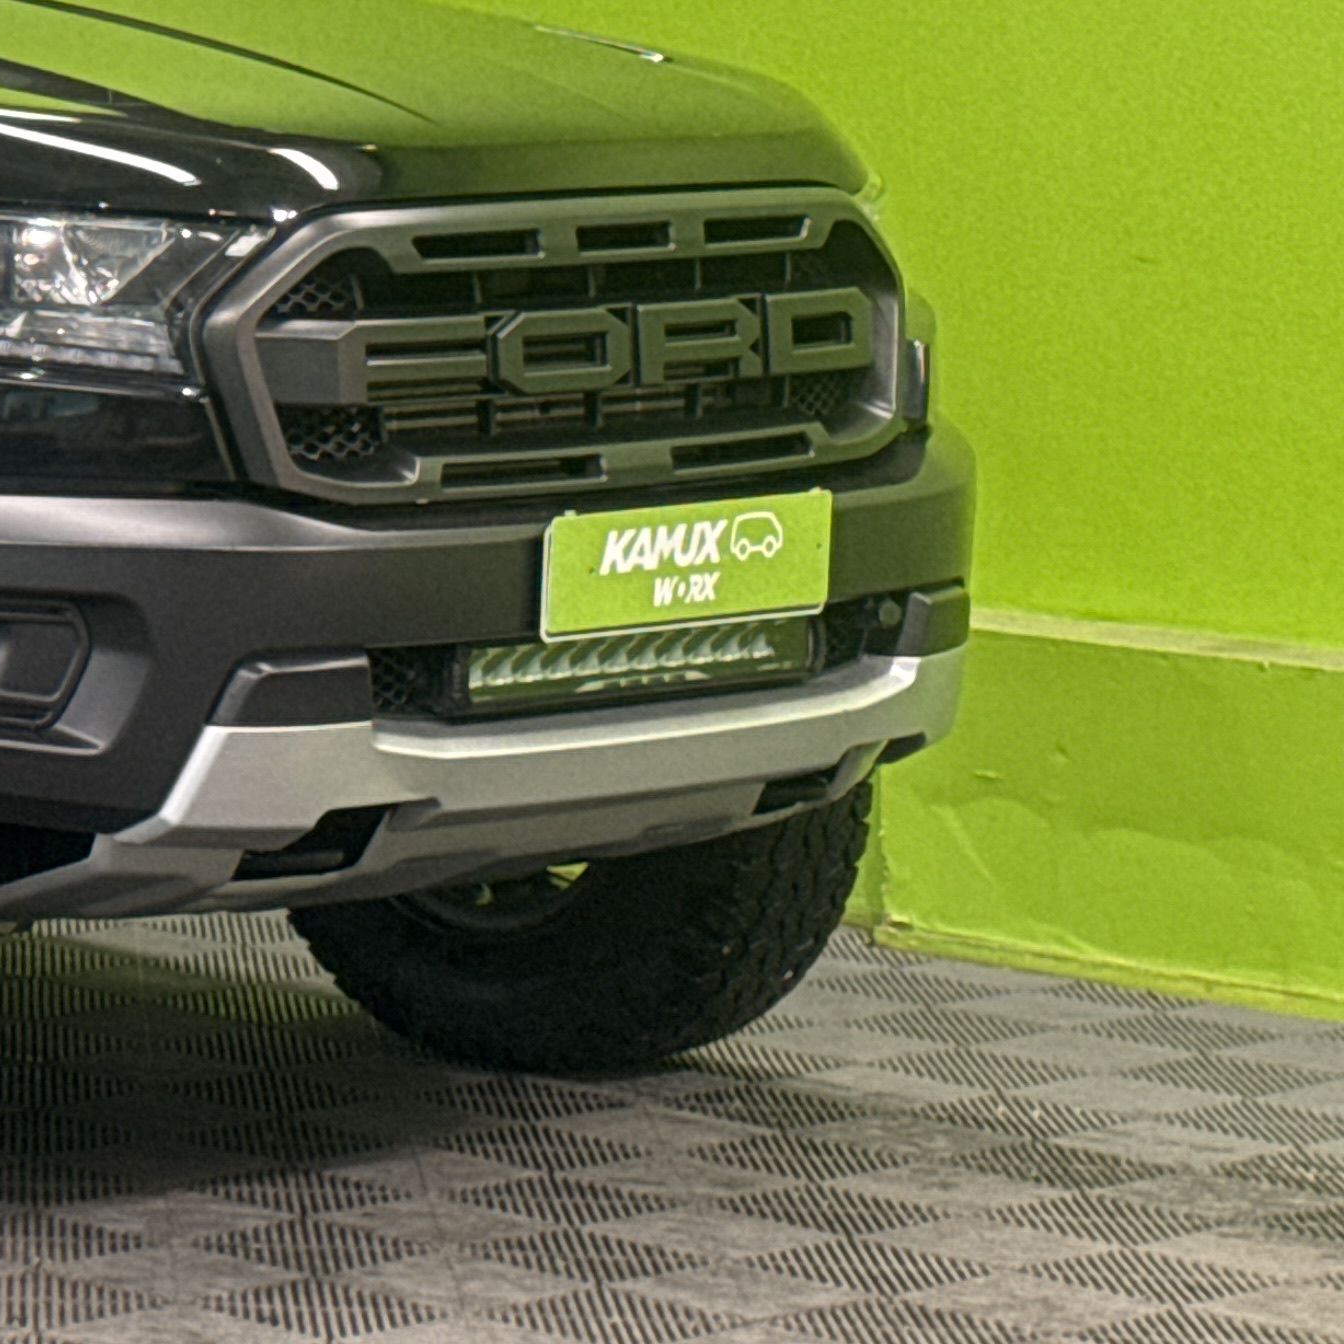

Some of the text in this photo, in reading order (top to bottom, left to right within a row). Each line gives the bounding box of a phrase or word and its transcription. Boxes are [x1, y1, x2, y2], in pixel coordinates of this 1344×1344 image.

[338, 286, 874, 404] FORD
[599, 519, 727, 576] KAMUX
[653, 571, 721, 607] WORX
